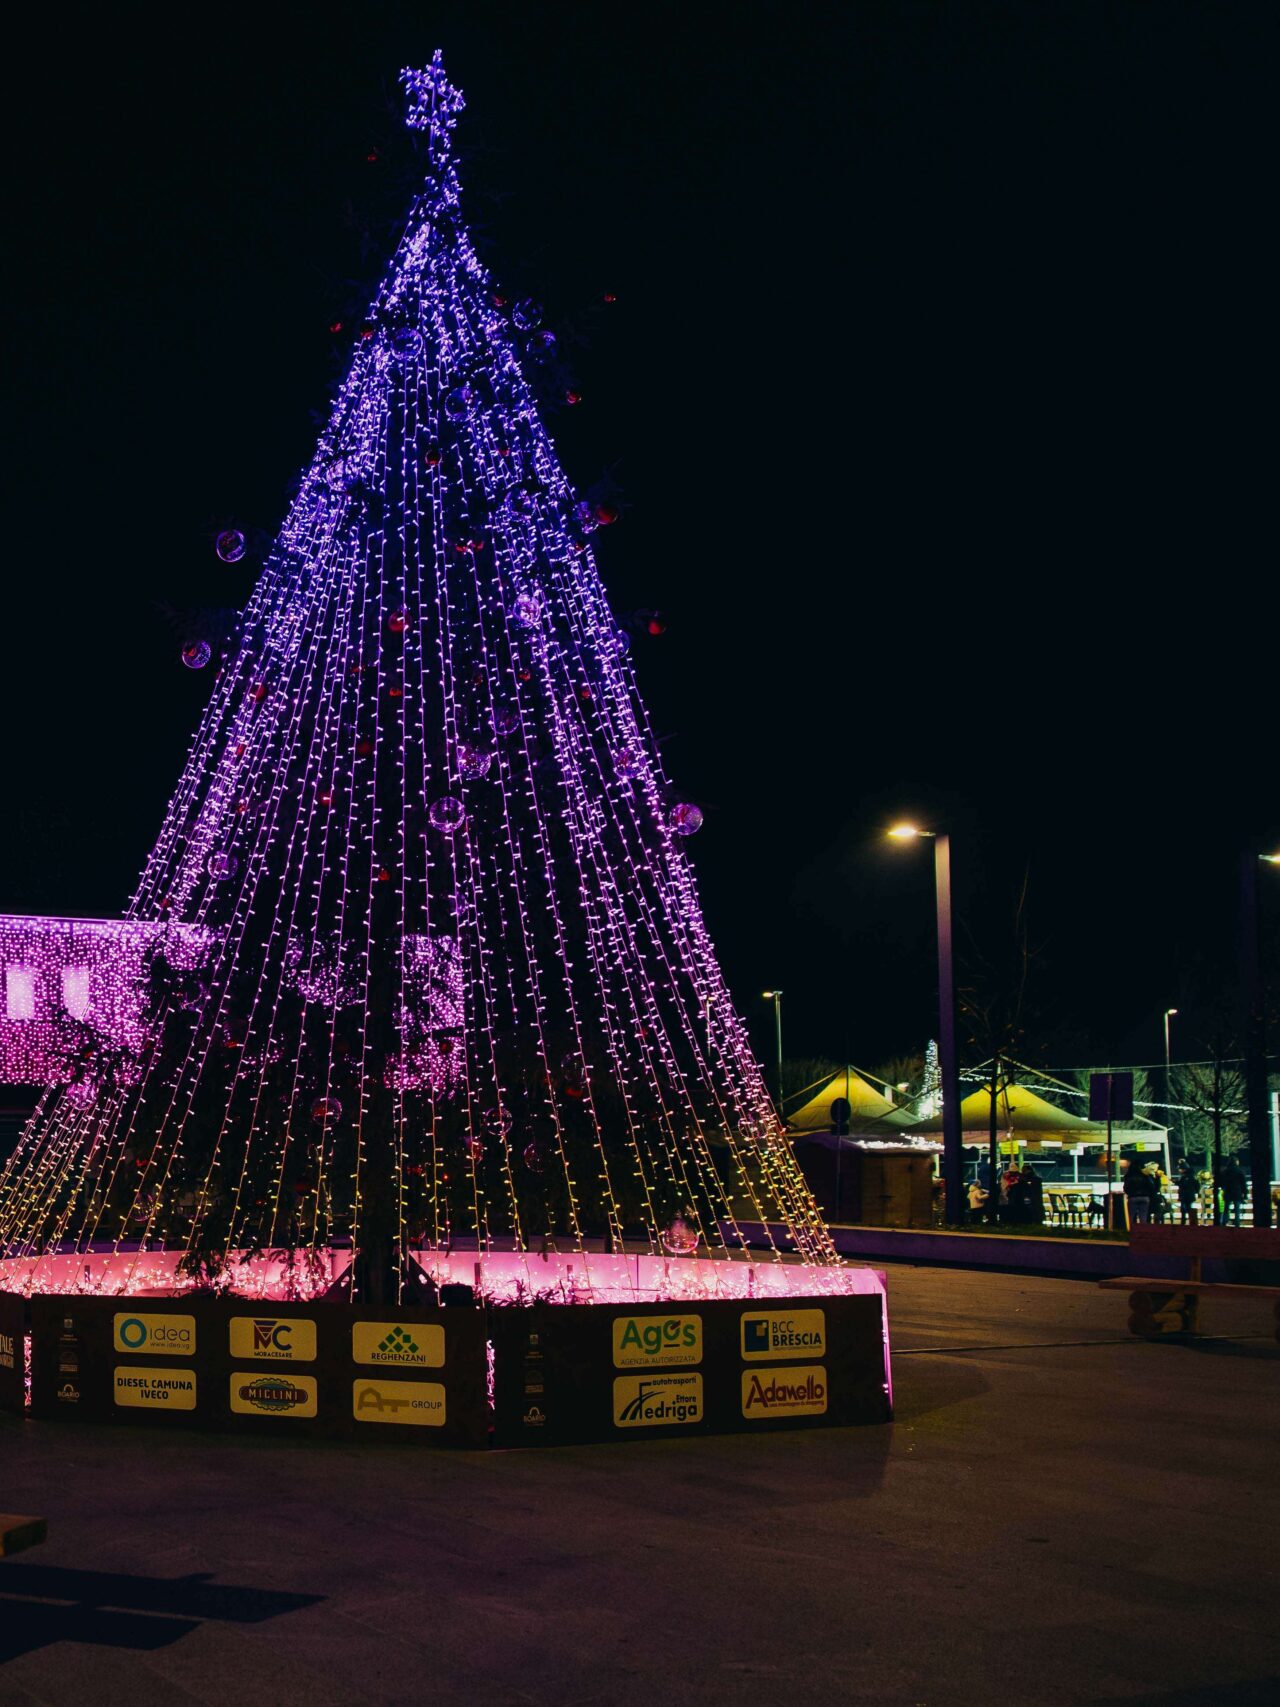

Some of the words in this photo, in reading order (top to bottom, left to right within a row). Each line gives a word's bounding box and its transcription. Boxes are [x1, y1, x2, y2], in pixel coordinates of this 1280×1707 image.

[150, 1324, 190, 1342] idea
[772, 1320, 794, 1334] BCC
[620, 1319, 696, 1354] Agos
[772, 1332, 822, 1347] BRESCIA
[371, 1352, 426, 1363] REGHENZANI
[117, 1378, 149, 1388] DIESEL
[152, 1380, 193, 1391] CAMUNA
[140, 1390, 169, 1400] IVECO
[411, 1400, 442, 1410] GROUP
